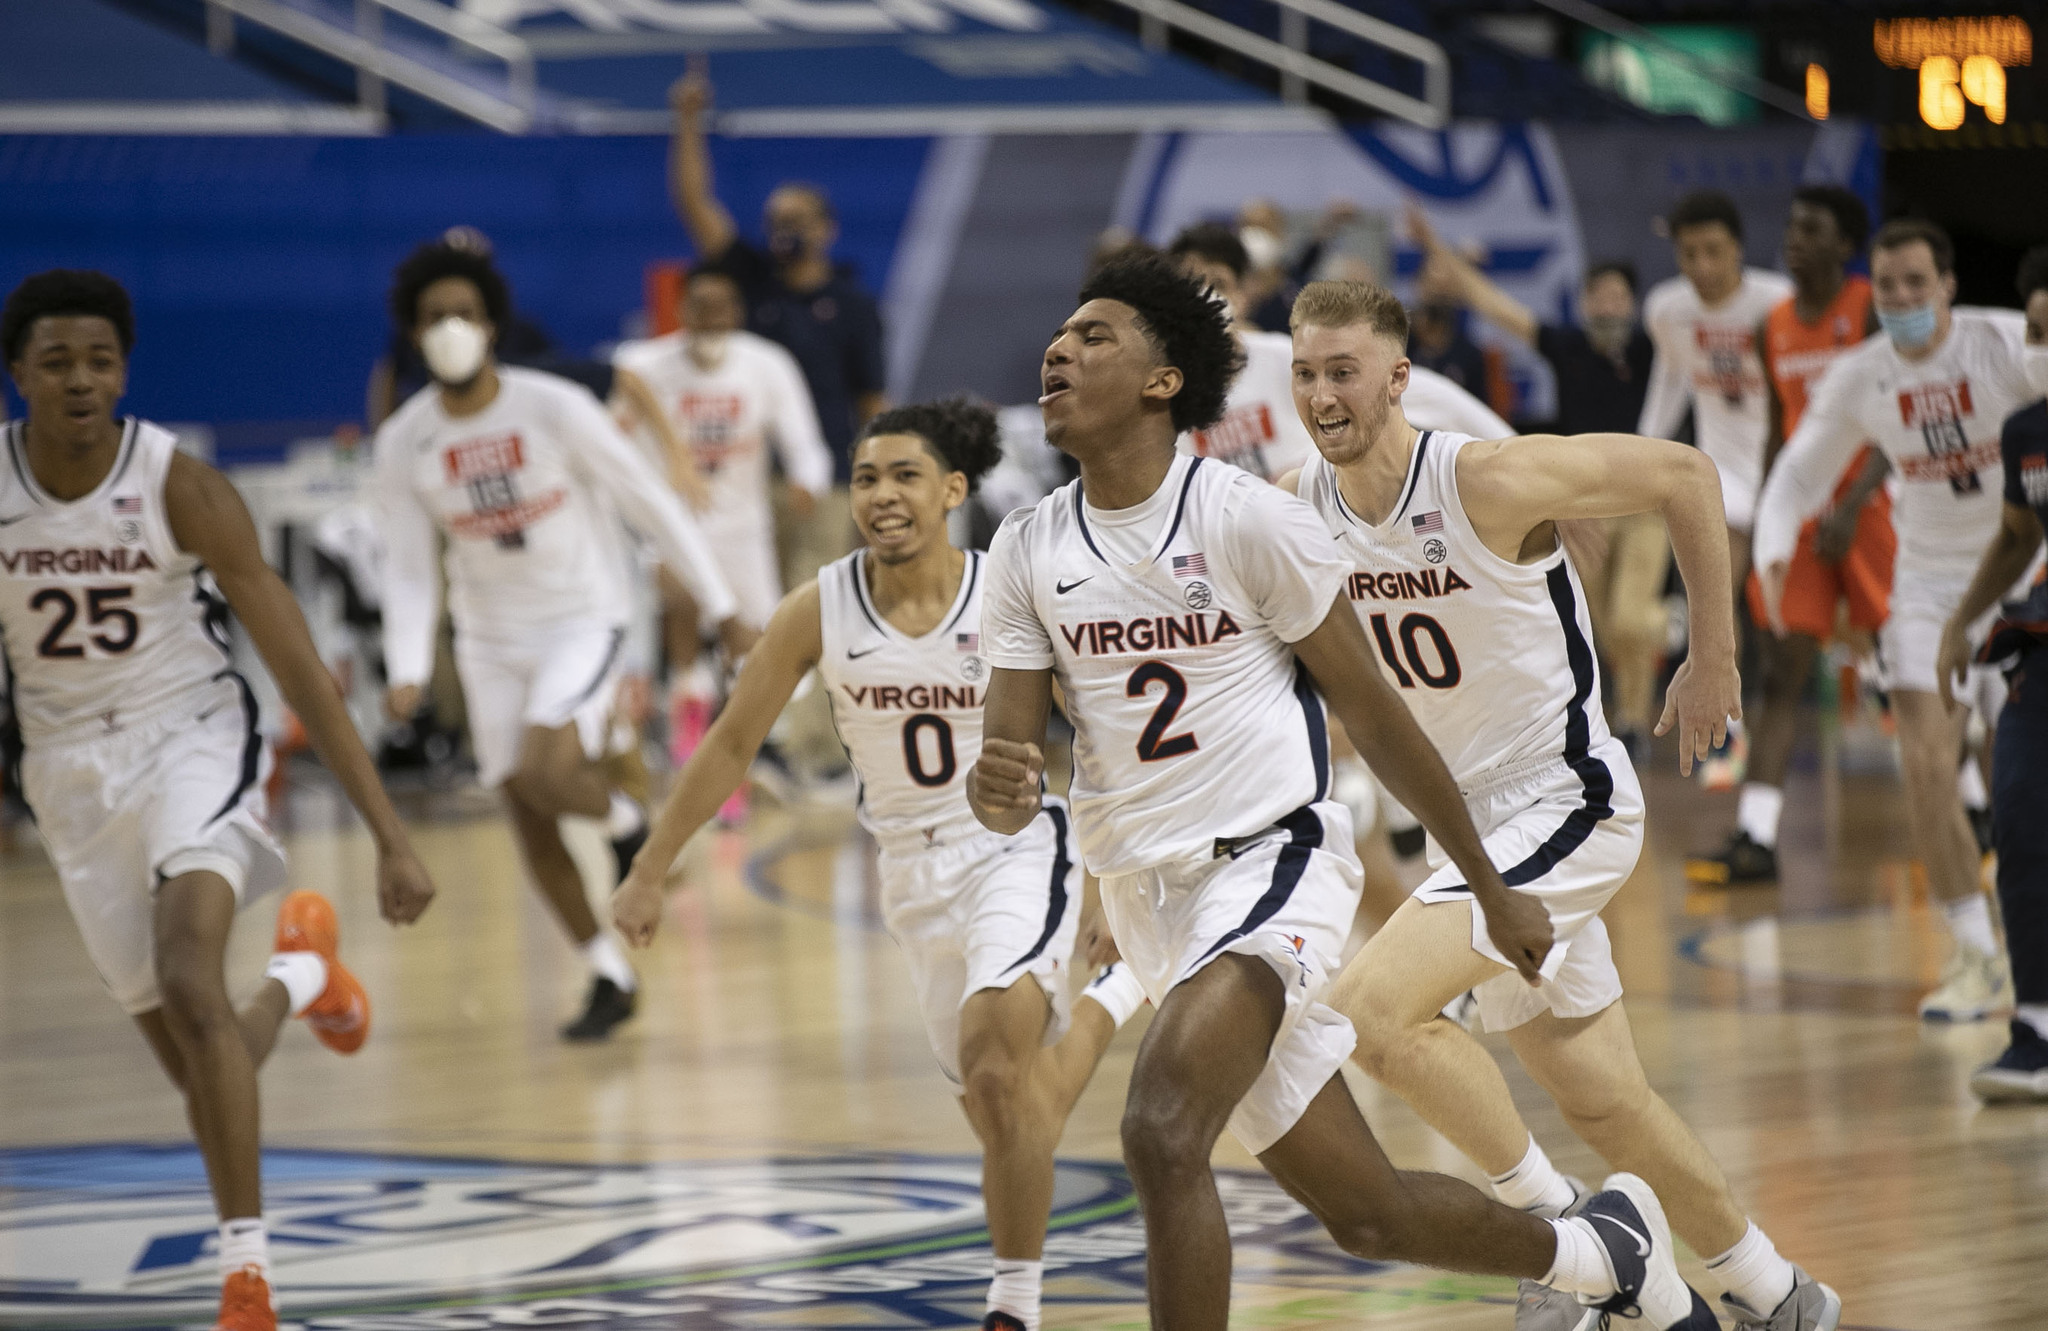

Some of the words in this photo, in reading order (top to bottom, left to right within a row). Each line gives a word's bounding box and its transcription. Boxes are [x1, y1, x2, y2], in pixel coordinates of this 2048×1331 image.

[0, 546, 156, 575] VIRGINIA
[1348, 566, 1473, 600] IRGINIA
[29, 587, 140, 659] 25
[1059, 609, 1242, 656] VIRGINIA
[1369, 612, 1461, 689] 10
[842, 683, 986, 710] VIRGINI
[1126, 659, 1200, 763] 2
[902, 713, 957, 789] 0
